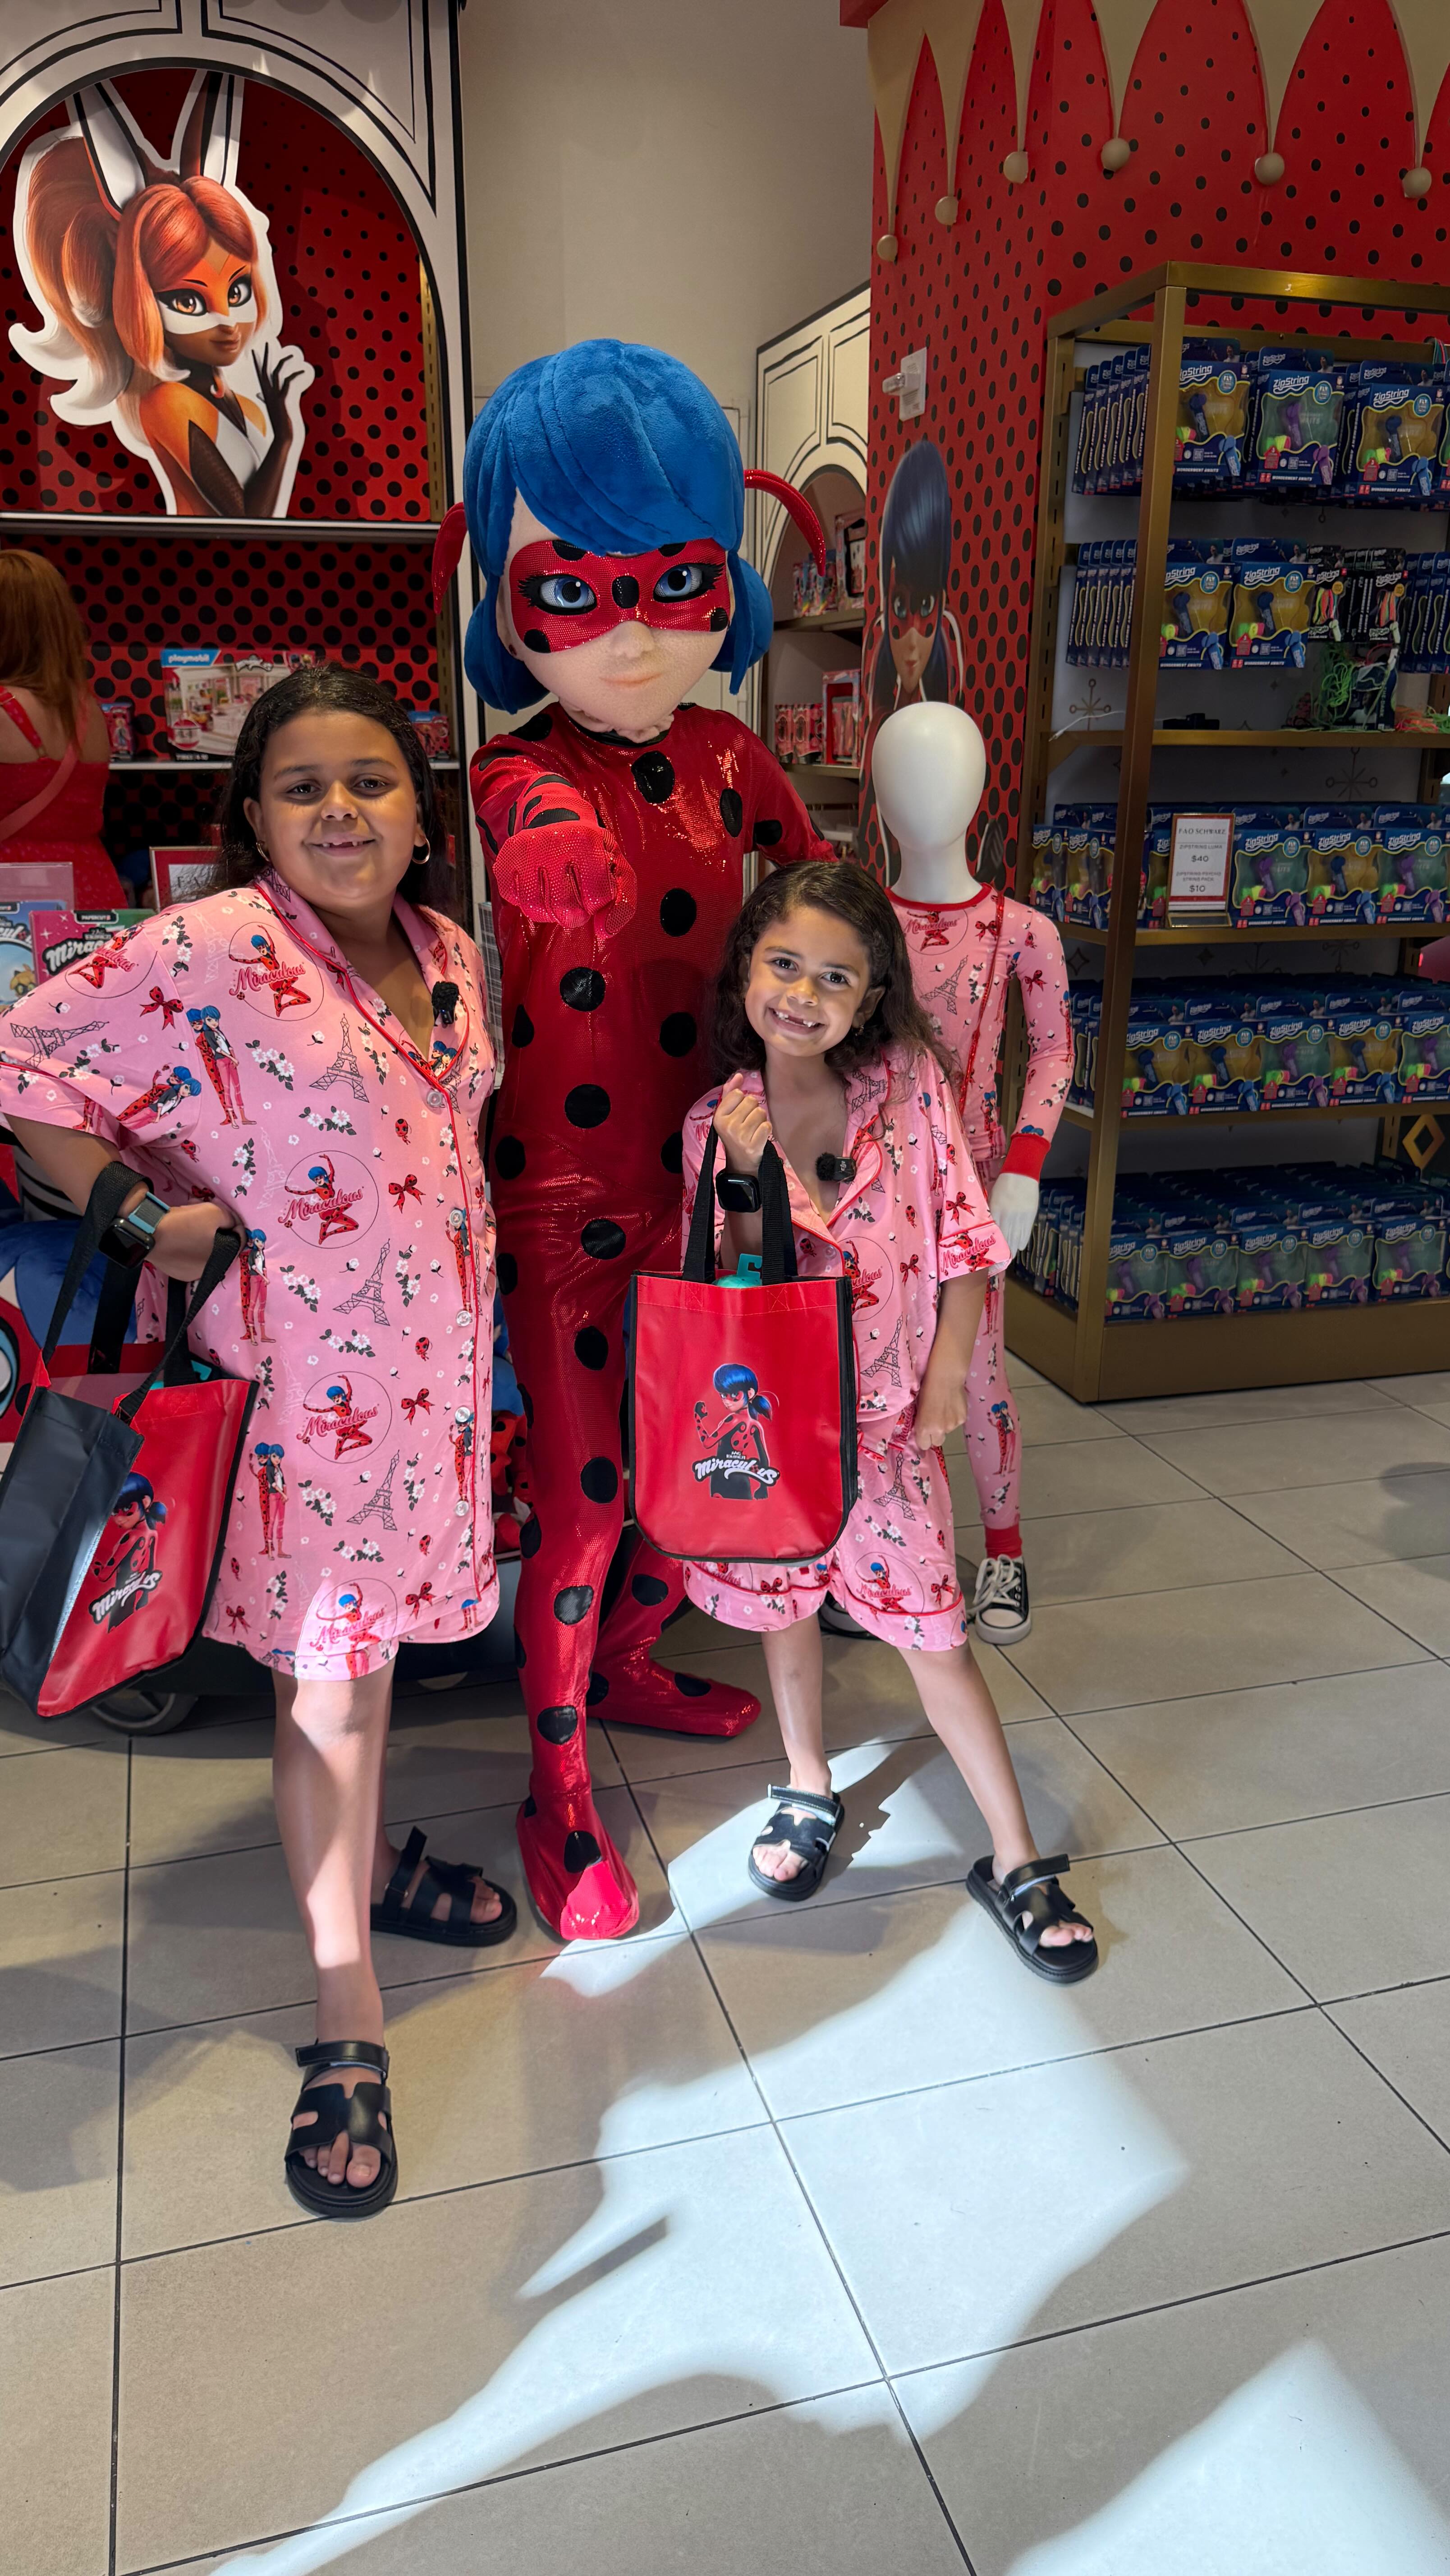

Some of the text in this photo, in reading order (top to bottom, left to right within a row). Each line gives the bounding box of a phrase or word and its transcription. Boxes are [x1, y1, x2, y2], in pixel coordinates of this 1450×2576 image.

[1180, 365, 1212, 382] ipString
[1273, 376, 1309, 394] ZipString
[1373, 389, 1409, 407] ZipString
[1165, 567, 1196, 585] pString
[1244, 566, 1280, 585] ZipString
[168, 653, 210, 663] playmobil
[1245, 833, 1279, 851] ZipString
[1318, 832, 1351, 851] ZipString
[229, 961, 306, 996] Miraculous
[278, 1188, 363, 1223] Miraculous
[941, 1235, 996, 1272] Miraculous
[296, 1407, 378, 1440] Miraculous
[310, 1607, 385, 1647] Miraculous
